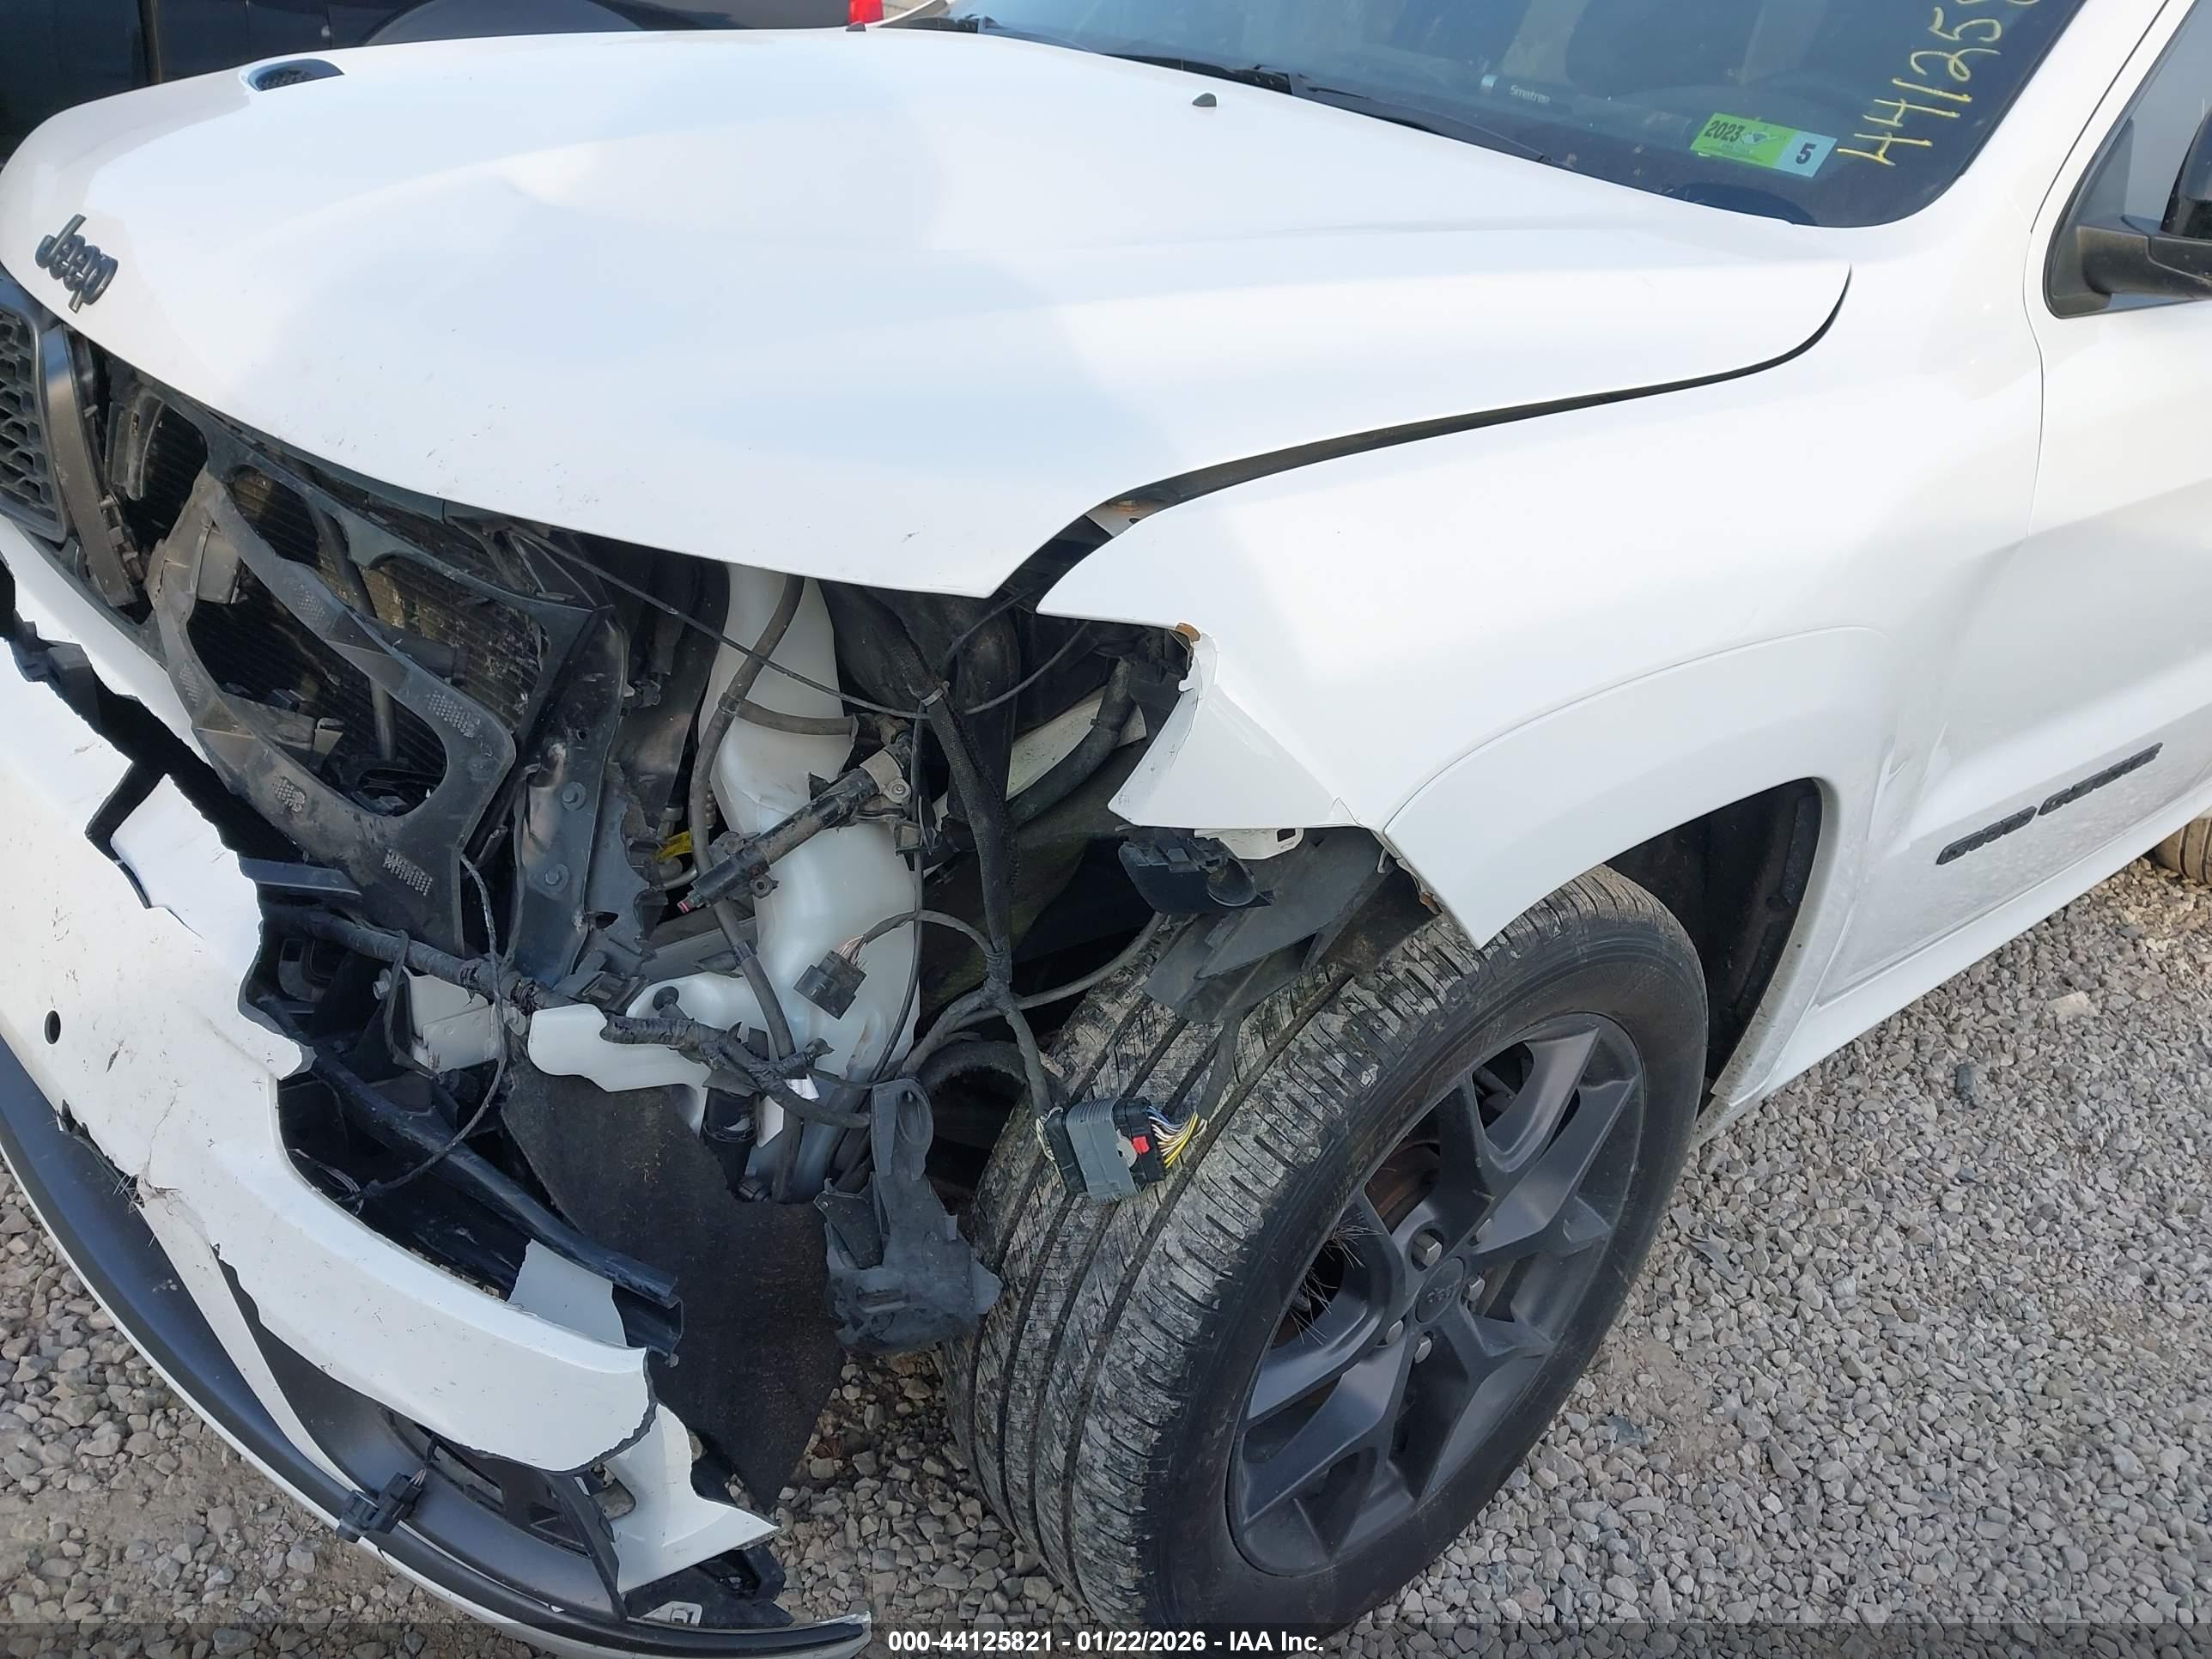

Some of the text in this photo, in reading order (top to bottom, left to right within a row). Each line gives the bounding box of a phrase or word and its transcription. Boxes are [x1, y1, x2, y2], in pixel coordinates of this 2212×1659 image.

[1836, 0, 2041, 167] 44125
[1704, 119, 1746, 143] 2023
[1795, 142, 1818, 165] 5
